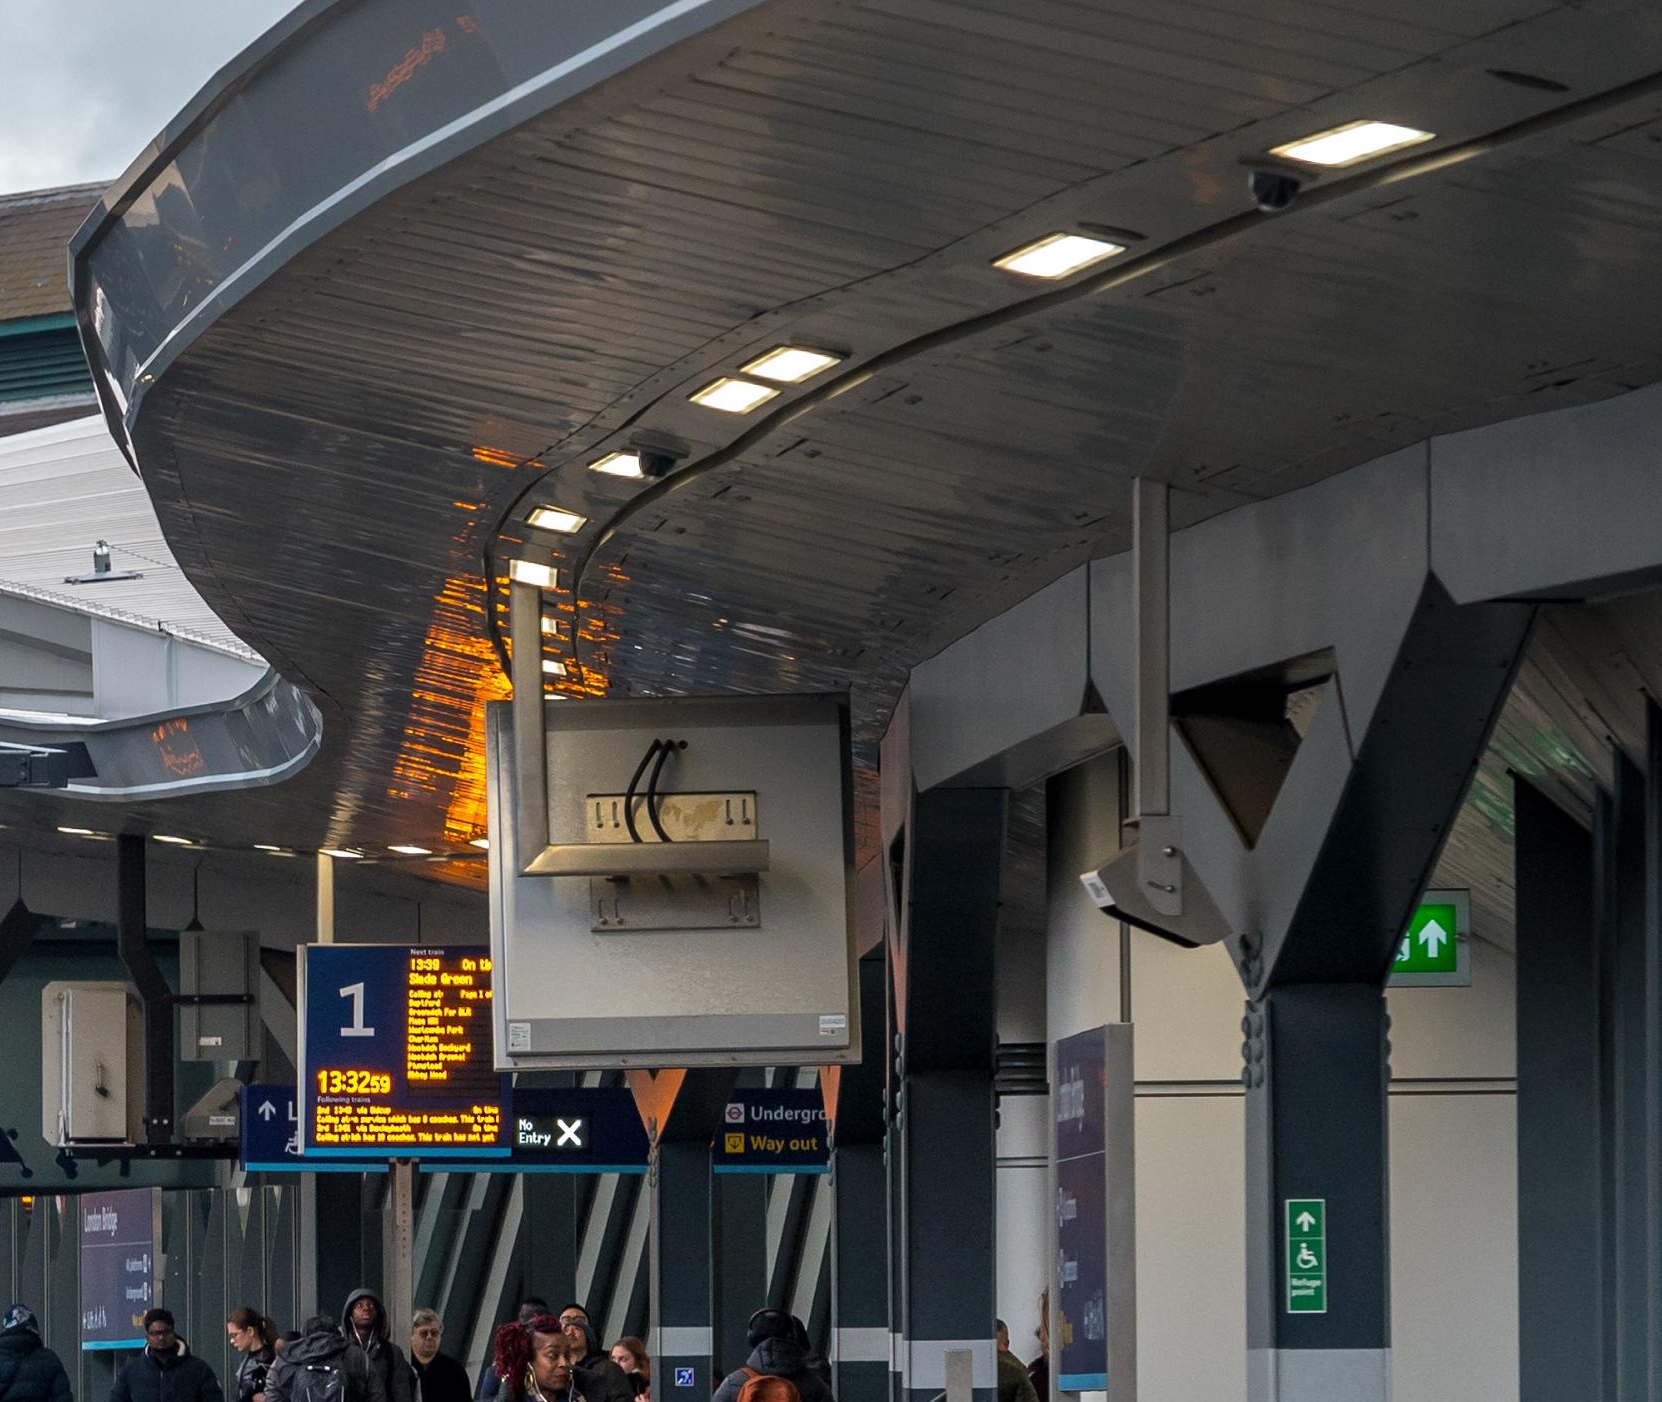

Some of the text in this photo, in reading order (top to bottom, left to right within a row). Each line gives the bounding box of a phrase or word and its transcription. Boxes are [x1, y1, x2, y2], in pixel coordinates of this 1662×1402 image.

[462, 959, 476, 971] On
[409, 973, 473, 985] Slade Green
[339, 982, 375, 1037] 1
[751, 1106, 826, 1123] Undergro
[519, 1119, 533, 1131] No
[519, 1132, 552, 1146] Entry
[751, 1135, 818, 1154] Way out
[1291, 1289, 1315, 1297] point
